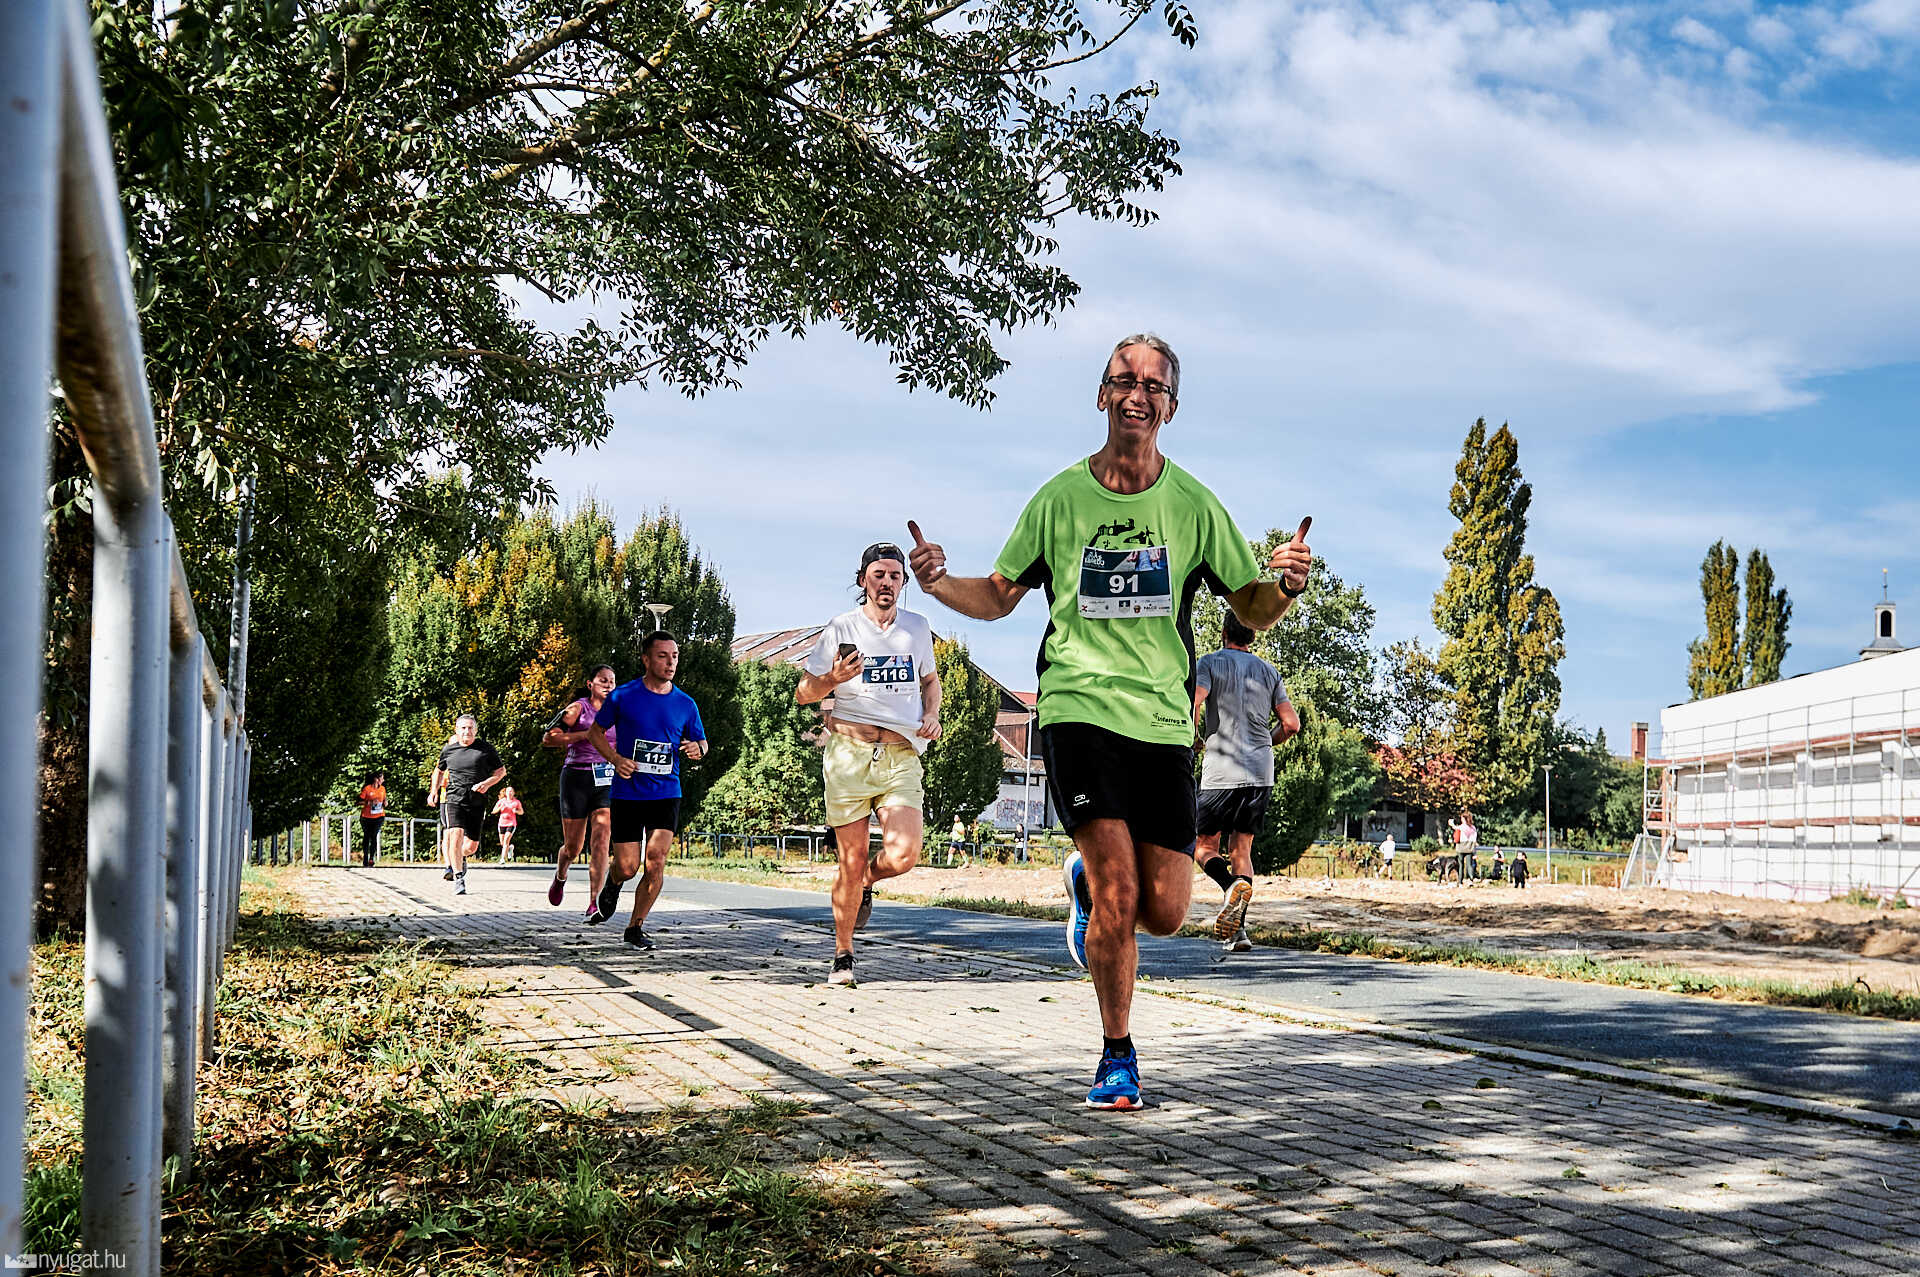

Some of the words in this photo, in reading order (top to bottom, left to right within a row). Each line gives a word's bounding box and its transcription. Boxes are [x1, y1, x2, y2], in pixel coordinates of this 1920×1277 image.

[1109, 574, 1139, 594] 91
[870, 668, 908, 682] 5116
[644, 752, 667, 764] 112
